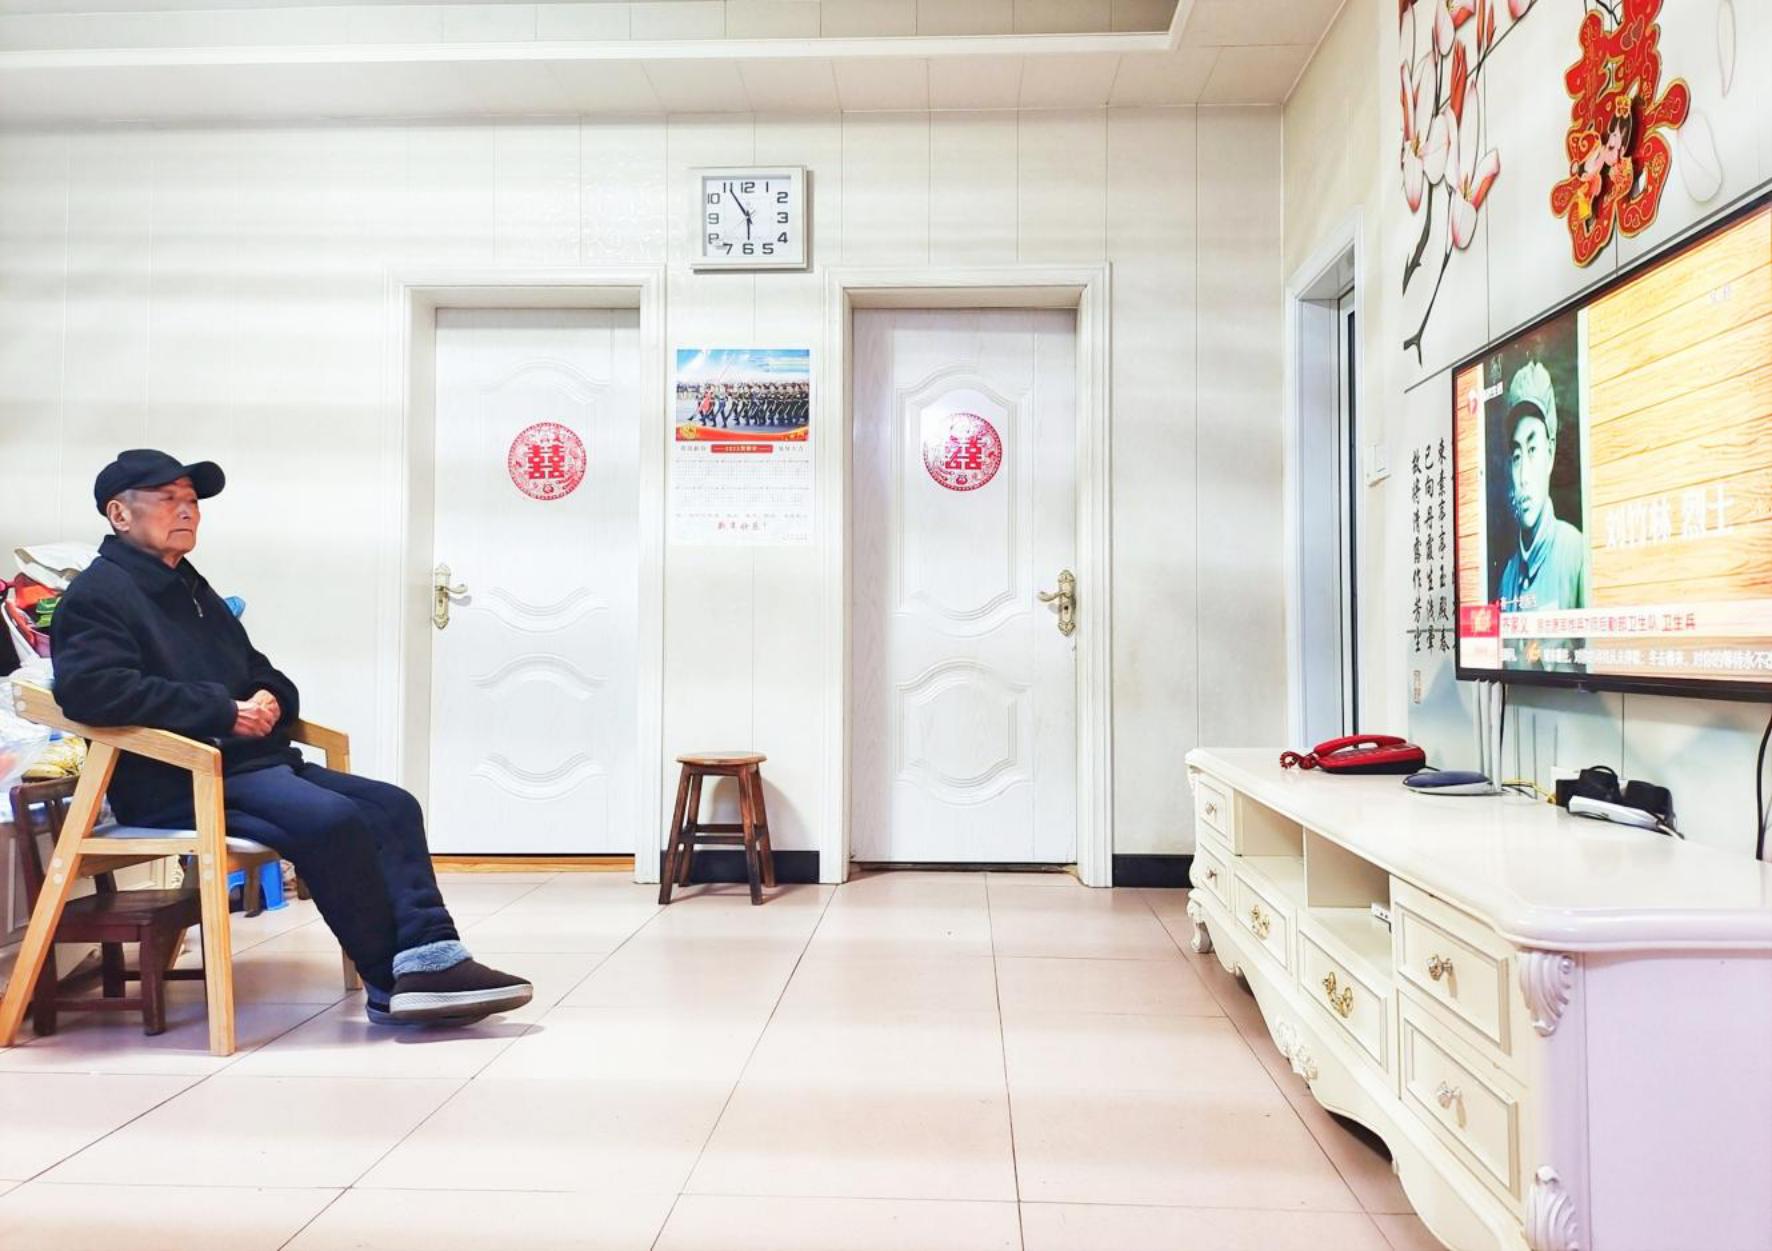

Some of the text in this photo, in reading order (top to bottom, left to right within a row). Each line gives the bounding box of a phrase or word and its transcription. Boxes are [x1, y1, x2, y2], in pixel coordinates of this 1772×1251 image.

[740, 181, 756, 194] 12
[707, 192, 721, 205] 10
[776, 191, 789, 204] 2
[708, 212, 720, 225] 9
[776, 211, 789, 224] 3
[776, 231, 789, 244] 4
[722, 242, 734, 255] 7
[742, 242, 755, 255] 6
[762, 242, 774, 255] 5
